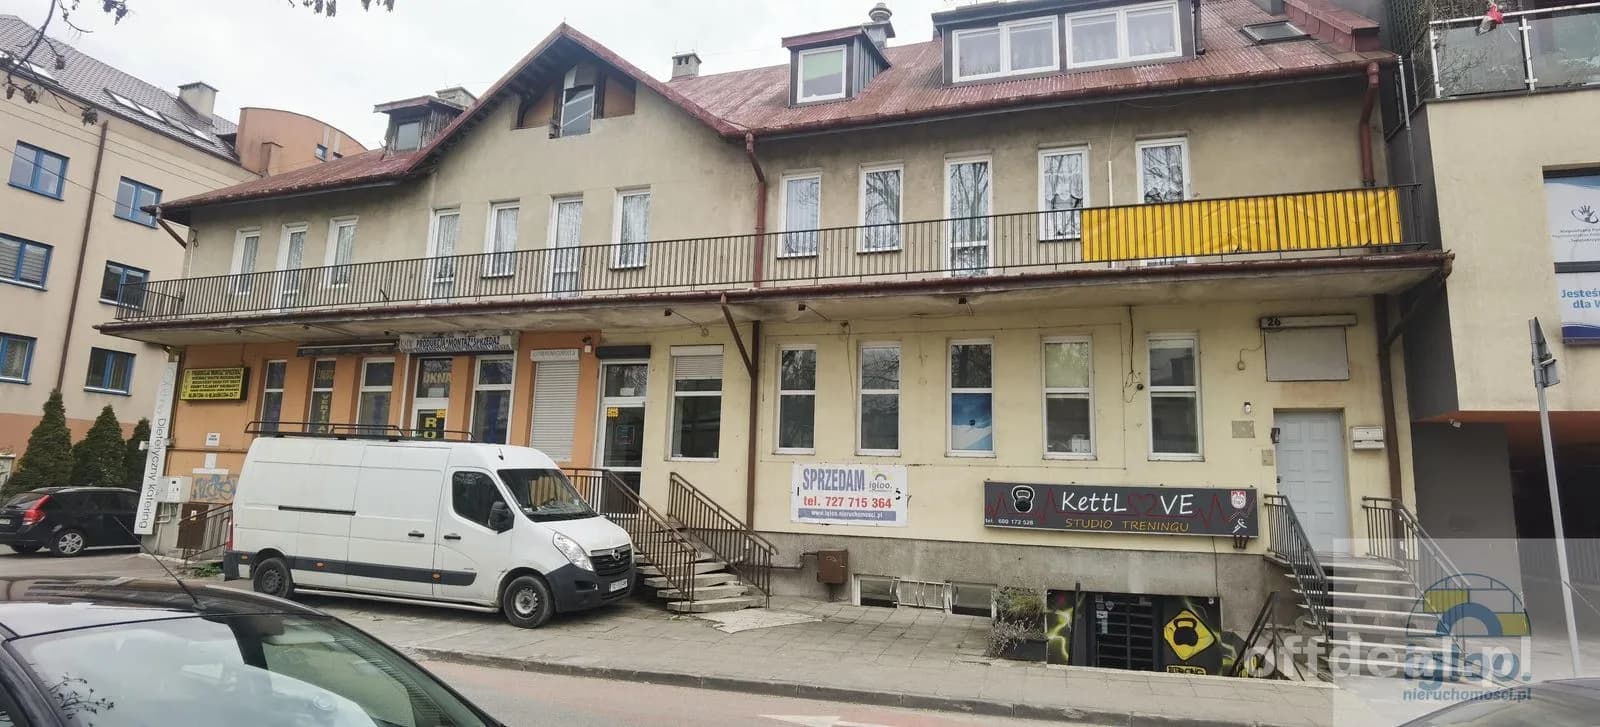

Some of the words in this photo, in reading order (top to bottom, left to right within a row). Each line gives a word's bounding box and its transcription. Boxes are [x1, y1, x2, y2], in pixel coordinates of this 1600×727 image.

[1561, 288, 1600, 299] Jesteś
[1573, 299, 1591, 309] dla
[1267, 318, 1281, 327] 26
[148, 418, 167, 481] Dietetyczny
[803, 468, 865, 491] SPRZEDAM
[139, 482, 157, 529] katering
[804, 496, 820, 506] tel.
[826, 497, 844, 507] 727
[848, 497, 867, 507] 715
[872, 498, 892, 508] 364
[1065, 518, 1113, 529] STUDIO
[1122, 520, 1189, 532] TRENINGU
